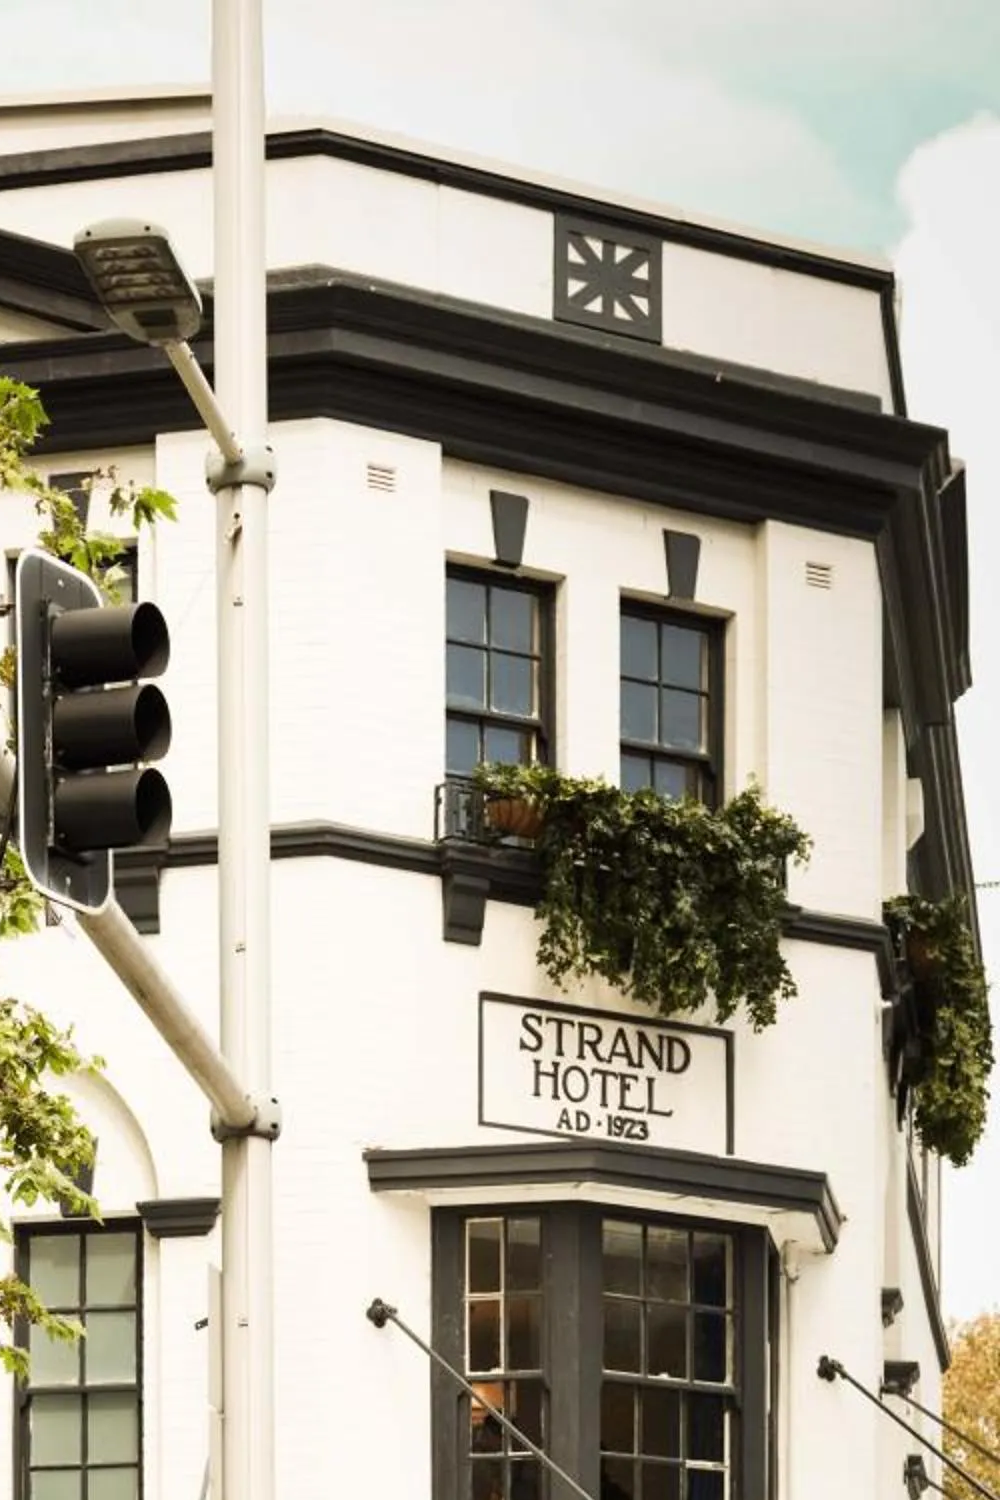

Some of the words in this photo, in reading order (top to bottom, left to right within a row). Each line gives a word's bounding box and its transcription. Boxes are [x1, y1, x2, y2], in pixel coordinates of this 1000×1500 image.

[519, 1012, 692, 1075] STRAND
[532, 1059, 674, 1118] HOTEL
[607, 1114, 650, 1141] 1923
